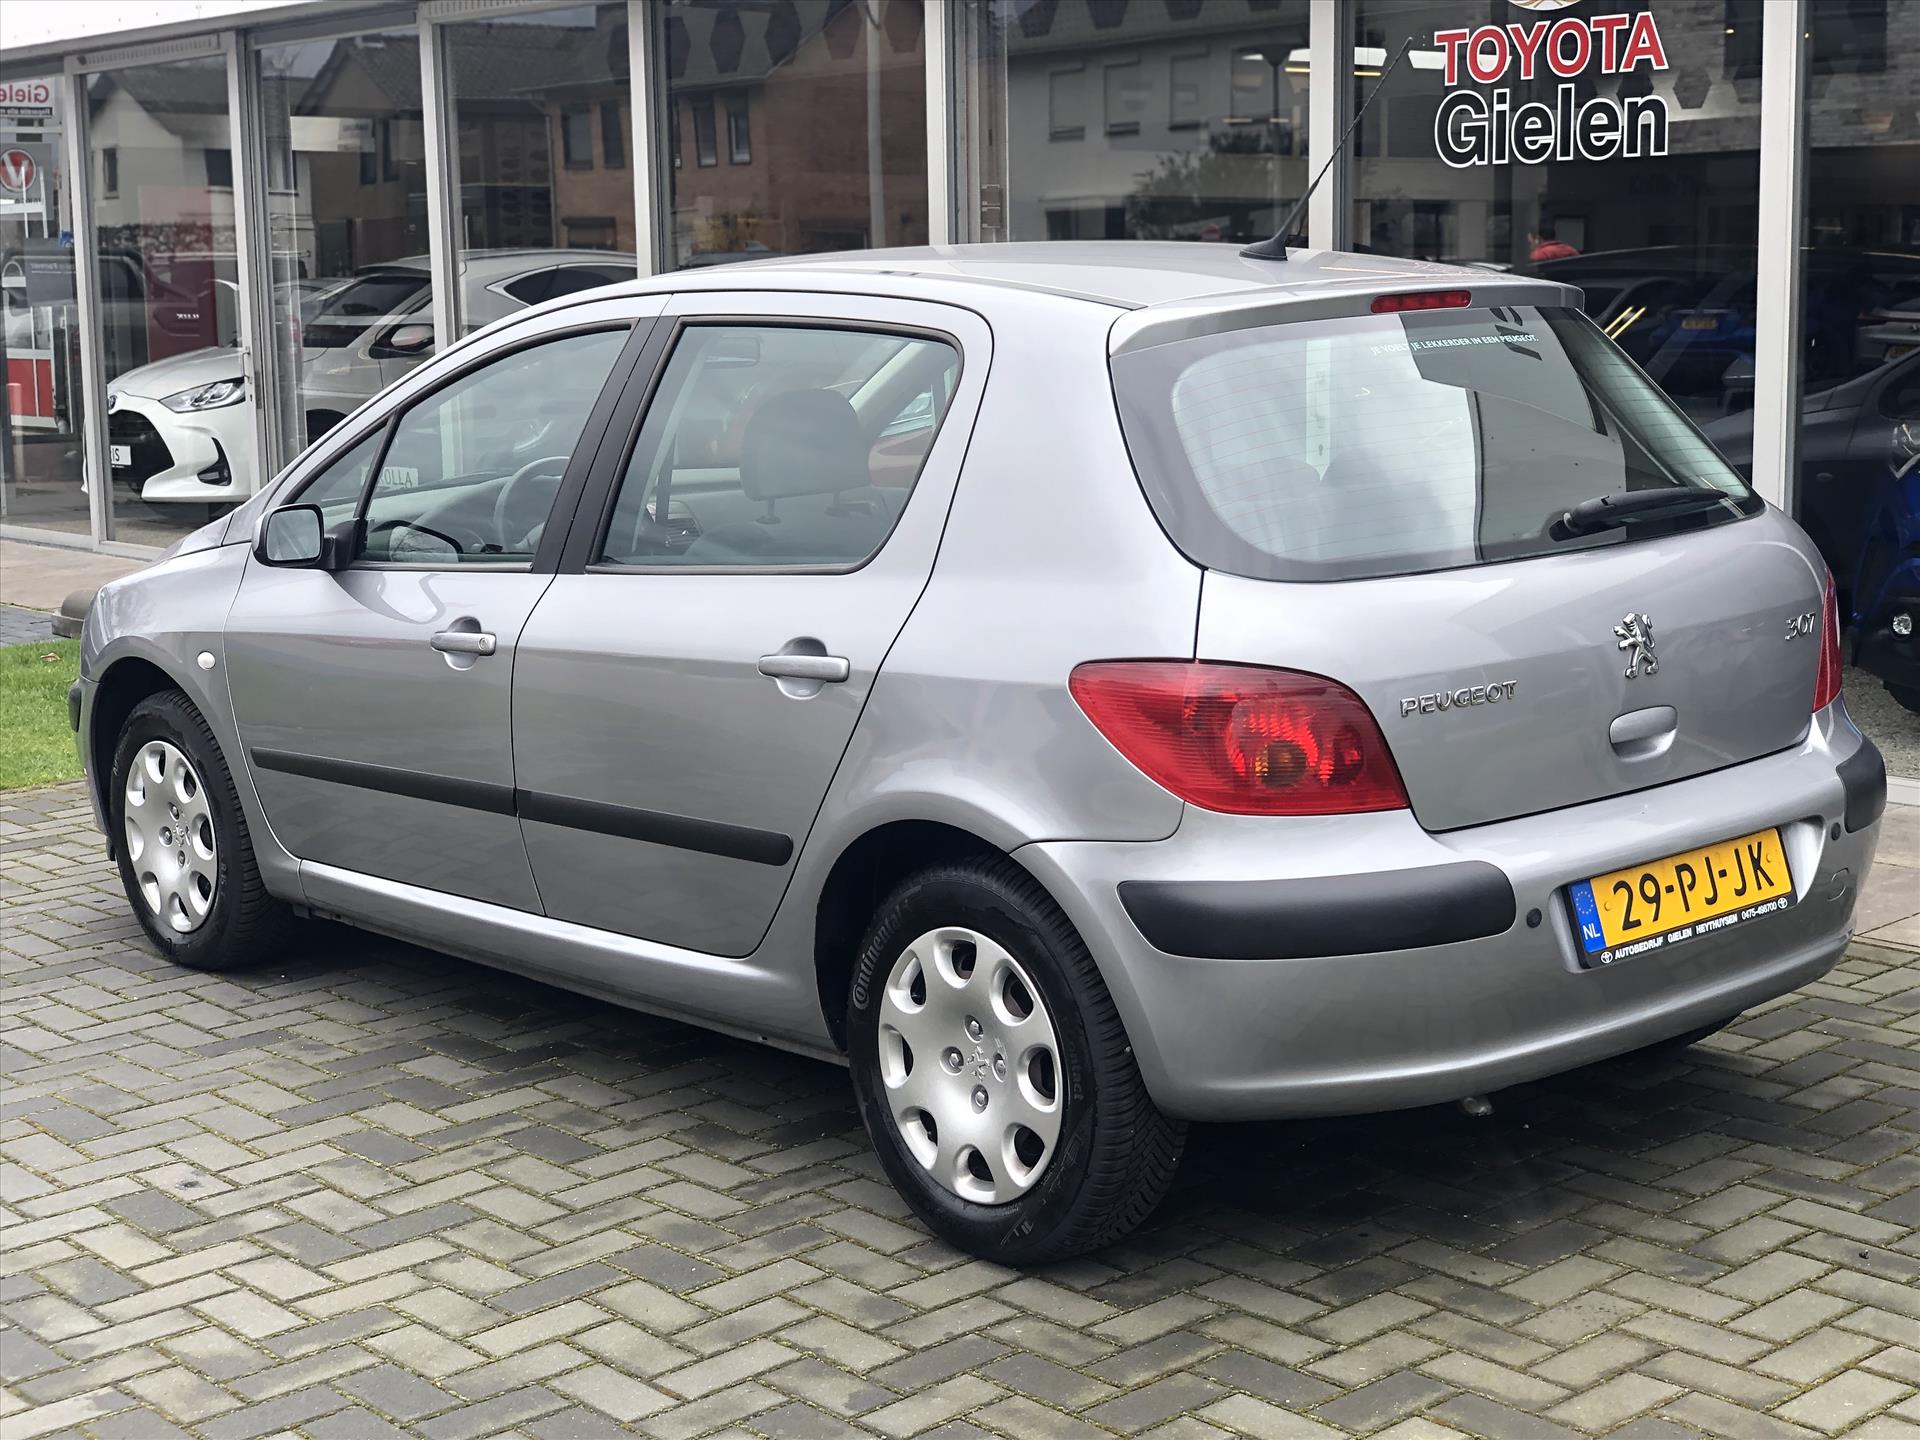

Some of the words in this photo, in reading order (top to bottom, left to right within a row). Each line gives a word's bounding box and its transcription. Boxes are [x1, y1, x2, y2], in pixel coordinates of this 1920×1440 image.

[1434, 11, 1669, 86] TOYOTA
[1434, 83, 1669, 168] Gielen
[1410, 341, 1421, 351] JE
[1421, 337, 1472, 349] LEKKERDER
[1471, 336, 1482, 345] IN
[1482, 335, 1500, 344] EEN
[381, 468, 413, 488] OLLA
[1785, 612, 1816, 640] 307
[1400, 680, 1517, 717] PEUGEOT
[1612, 841, 1775, 931] 29-PJ-JK
[1582, 922, 1600, 941] NL
[1615, 936, 1664, 960] AUTOBEDRIJF
[1667, 928, 1692, 943] GIELEN
[1696, 914, 1738, 935] HEYTHUYSEN
